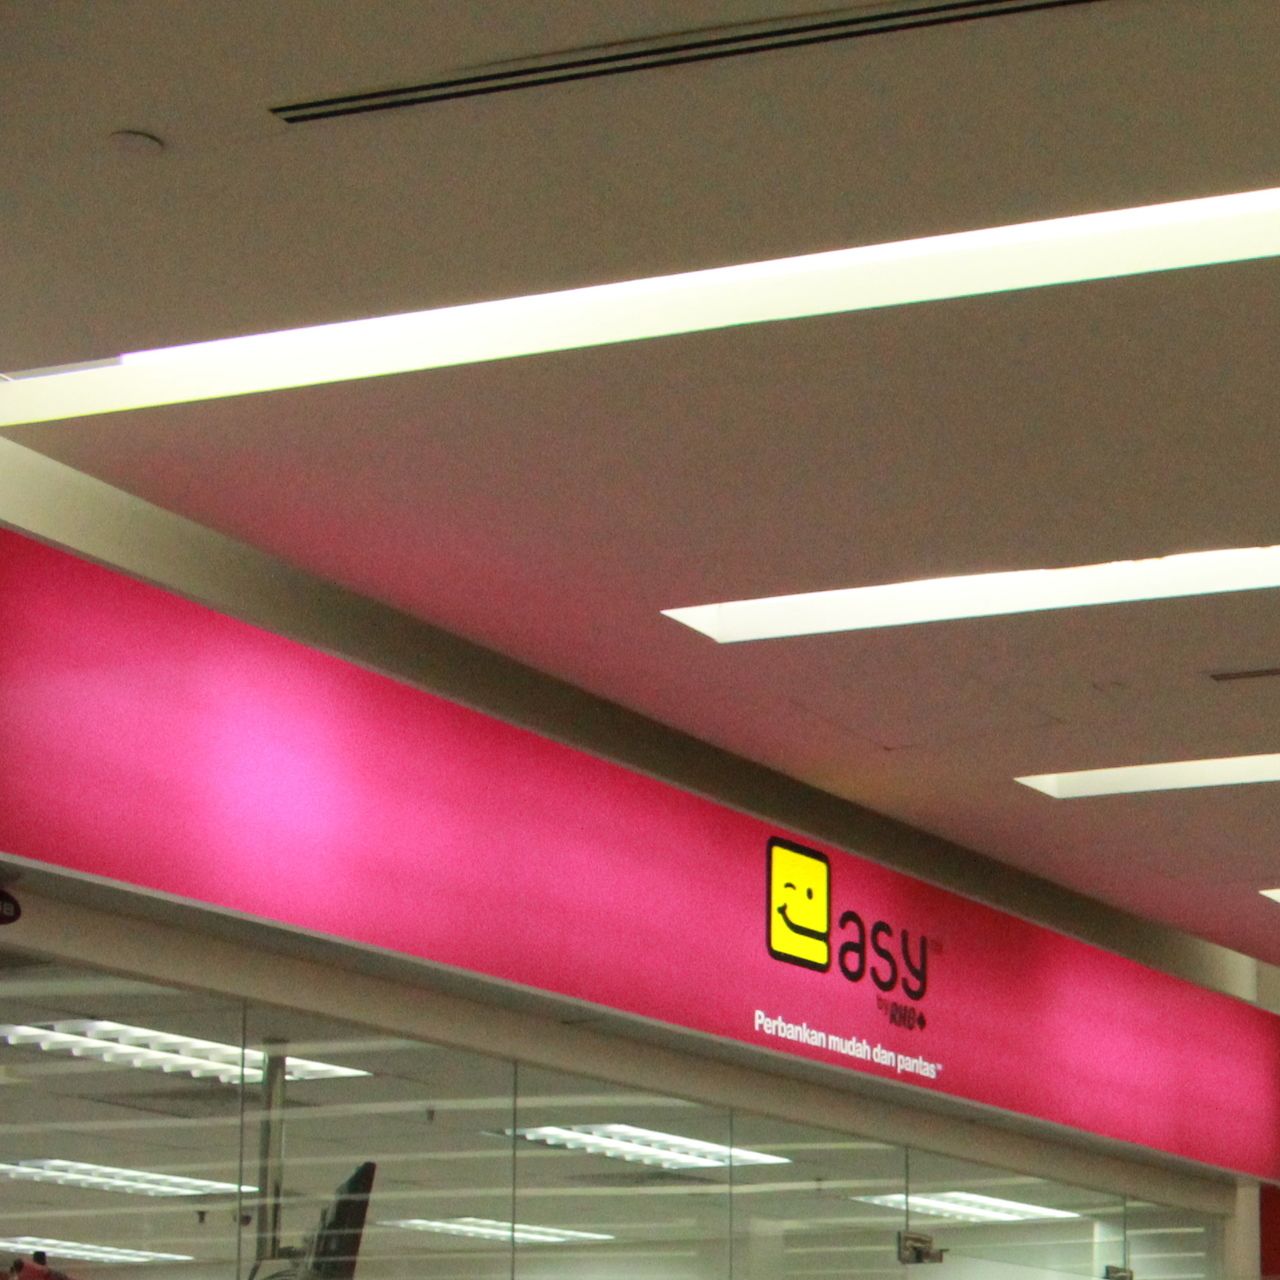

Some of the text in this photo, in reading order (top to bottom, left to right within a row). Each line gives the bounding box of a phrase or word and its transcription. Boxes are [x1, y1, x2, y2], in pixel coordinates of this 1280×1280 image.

[754, 1009, 827, 1049] Perbankan
[828, 1034, 871, 1060] mudah
[872, 1045, 896, 1068] dan
